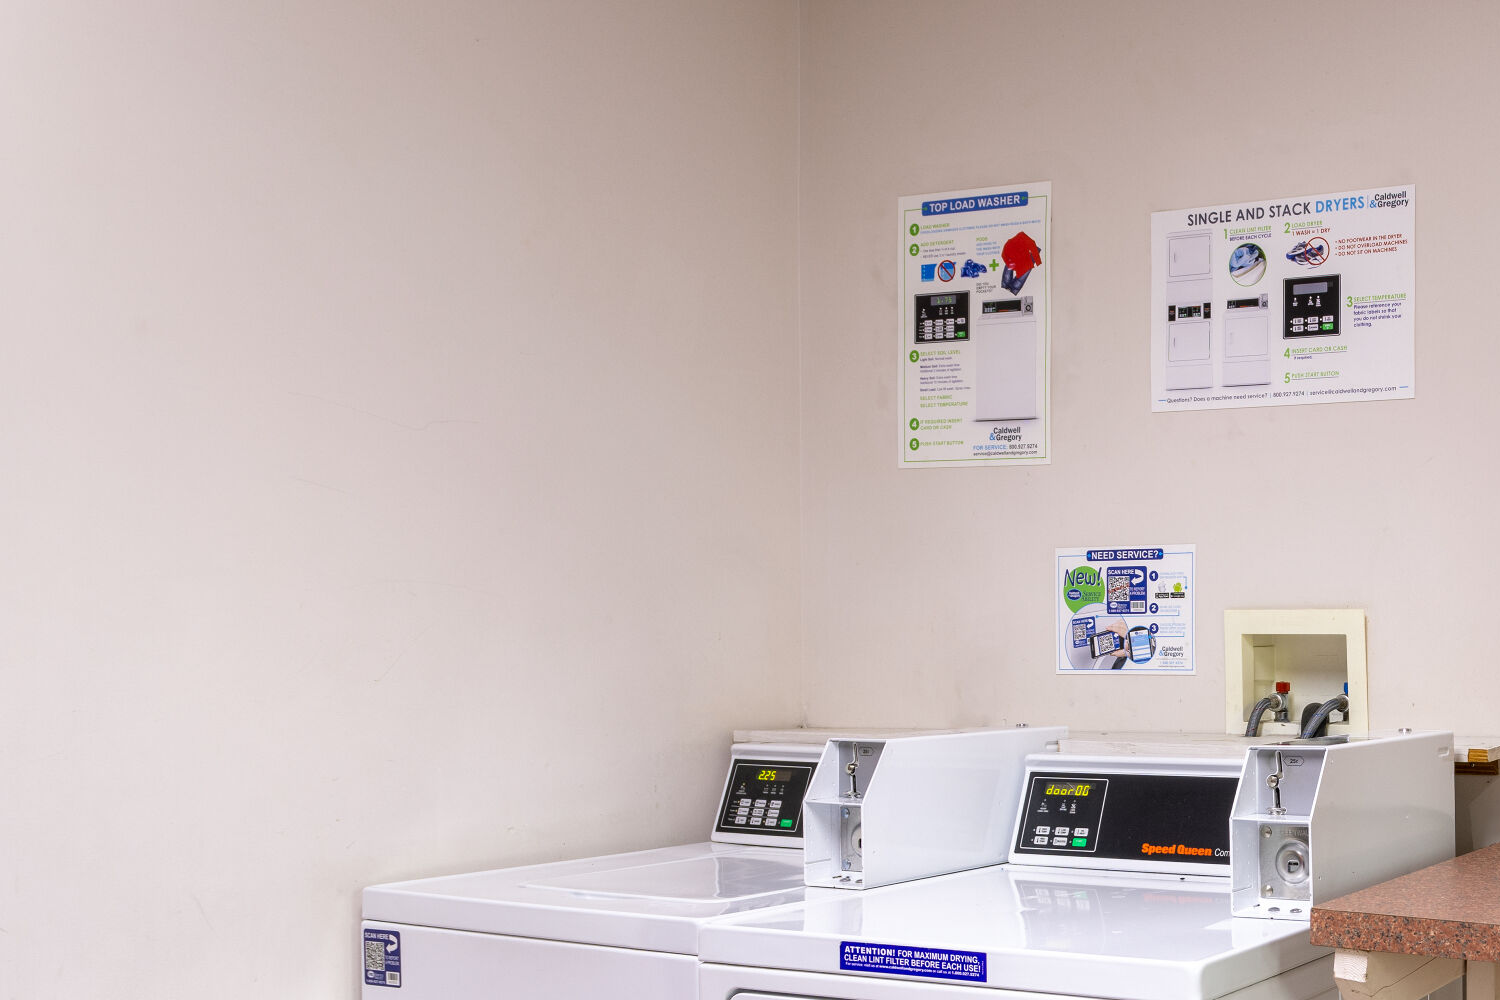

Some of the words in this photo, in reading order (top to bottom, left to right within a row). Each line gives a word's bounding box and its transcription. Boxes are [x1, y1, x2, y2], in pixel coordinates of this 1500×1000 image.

[1374, 191, 1407, 201] Caldwell
[929, 202, 947, 212] TOP
[950, 200, 975, 211] LOAD
[978, 195, 1020, 208] WASHER
[1188, 211, 1231, 226] SINGLE
[1236, 207, 1264, 221] AND
[1269, 202, 1310, 218] STACK
[1316, 196, 1364, 213] DRYERS
[1224, 228, 1227, 239] 1
[1284, 222, 1291, 234] 2
[1346, 296, 1353, 308] 3
[1284, 347, 1290, 359] 4
[1284, 372, 1290, 383] 5
[1091, 551, 1114, 560] NEED
[1116, 550, 1158, 559] SERVICE?
[1064, 567, 1102, 586] New!
[1141, 843, 1176, 855] Speed
[1177, 844, 1212, 856] Queen
[845, 946, 896, 957] ATTENTION!
[898, 950, 912, 958] FOR
[914, 951, 948, 961] MAXIMUM
[950, 954, 980, 965] DRYING,
[844, 954, 867, 963] CLEAN
[886, 957, 909, 966] FILTER
[911, 960, 940, 969] BEFORE
[941, 963, 962, 971] EACH
[964, 964, 981, 972] USE!
